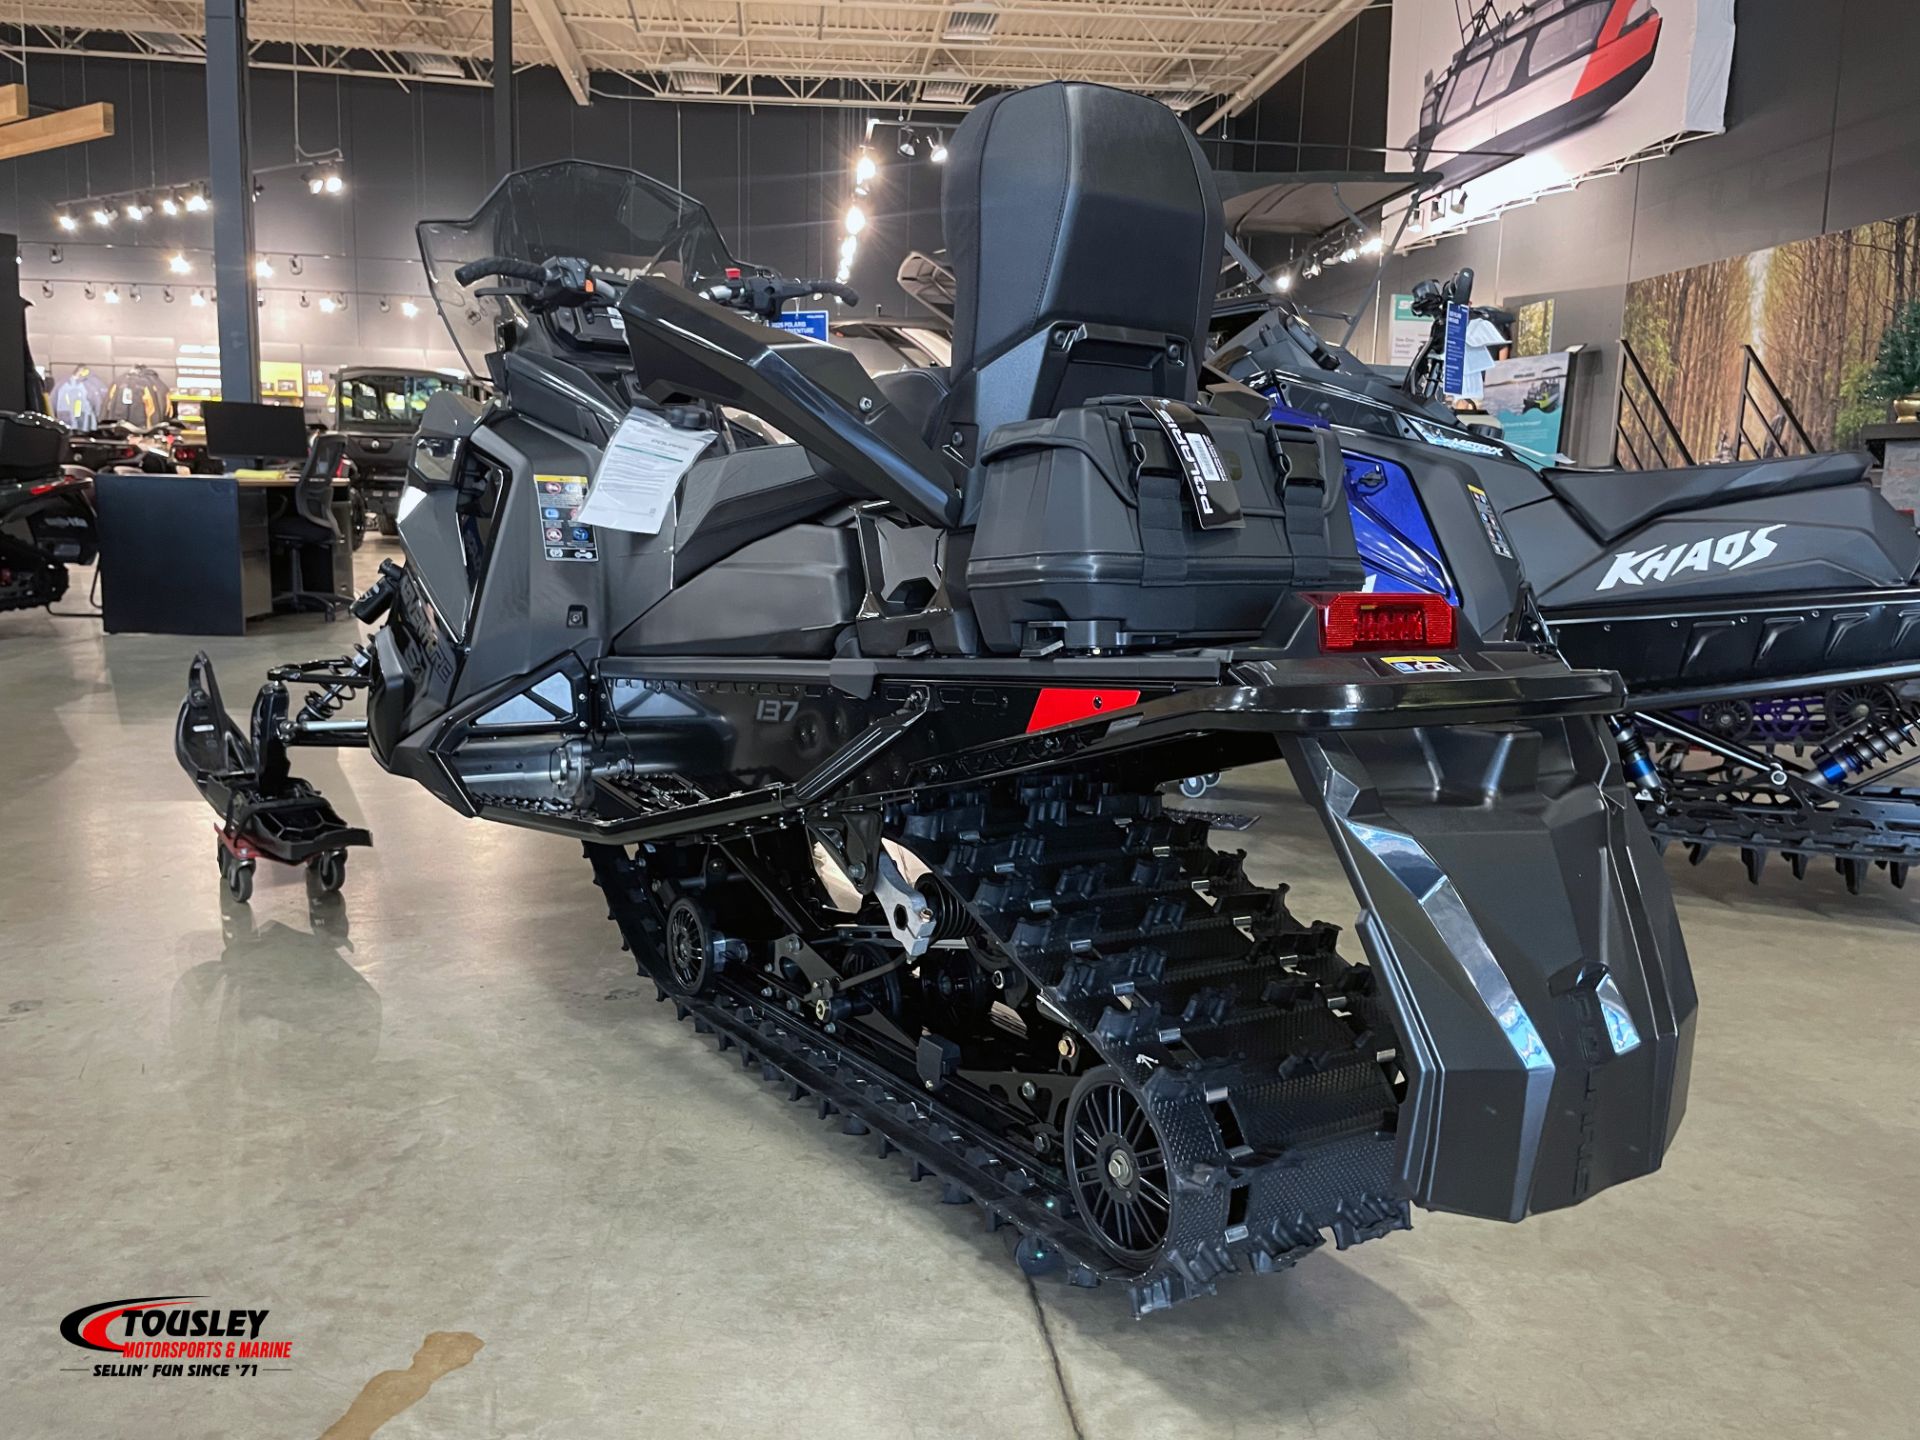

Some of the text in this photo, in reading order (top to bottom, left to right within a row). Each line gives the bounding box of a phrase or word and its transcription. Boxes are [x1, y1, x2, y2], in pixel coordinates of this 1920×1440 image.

[1155, 408, 1214, 514] POLARIS
[1595, 523, 1787, 591] KHAOS
[756, 699, 800, 722] 137
